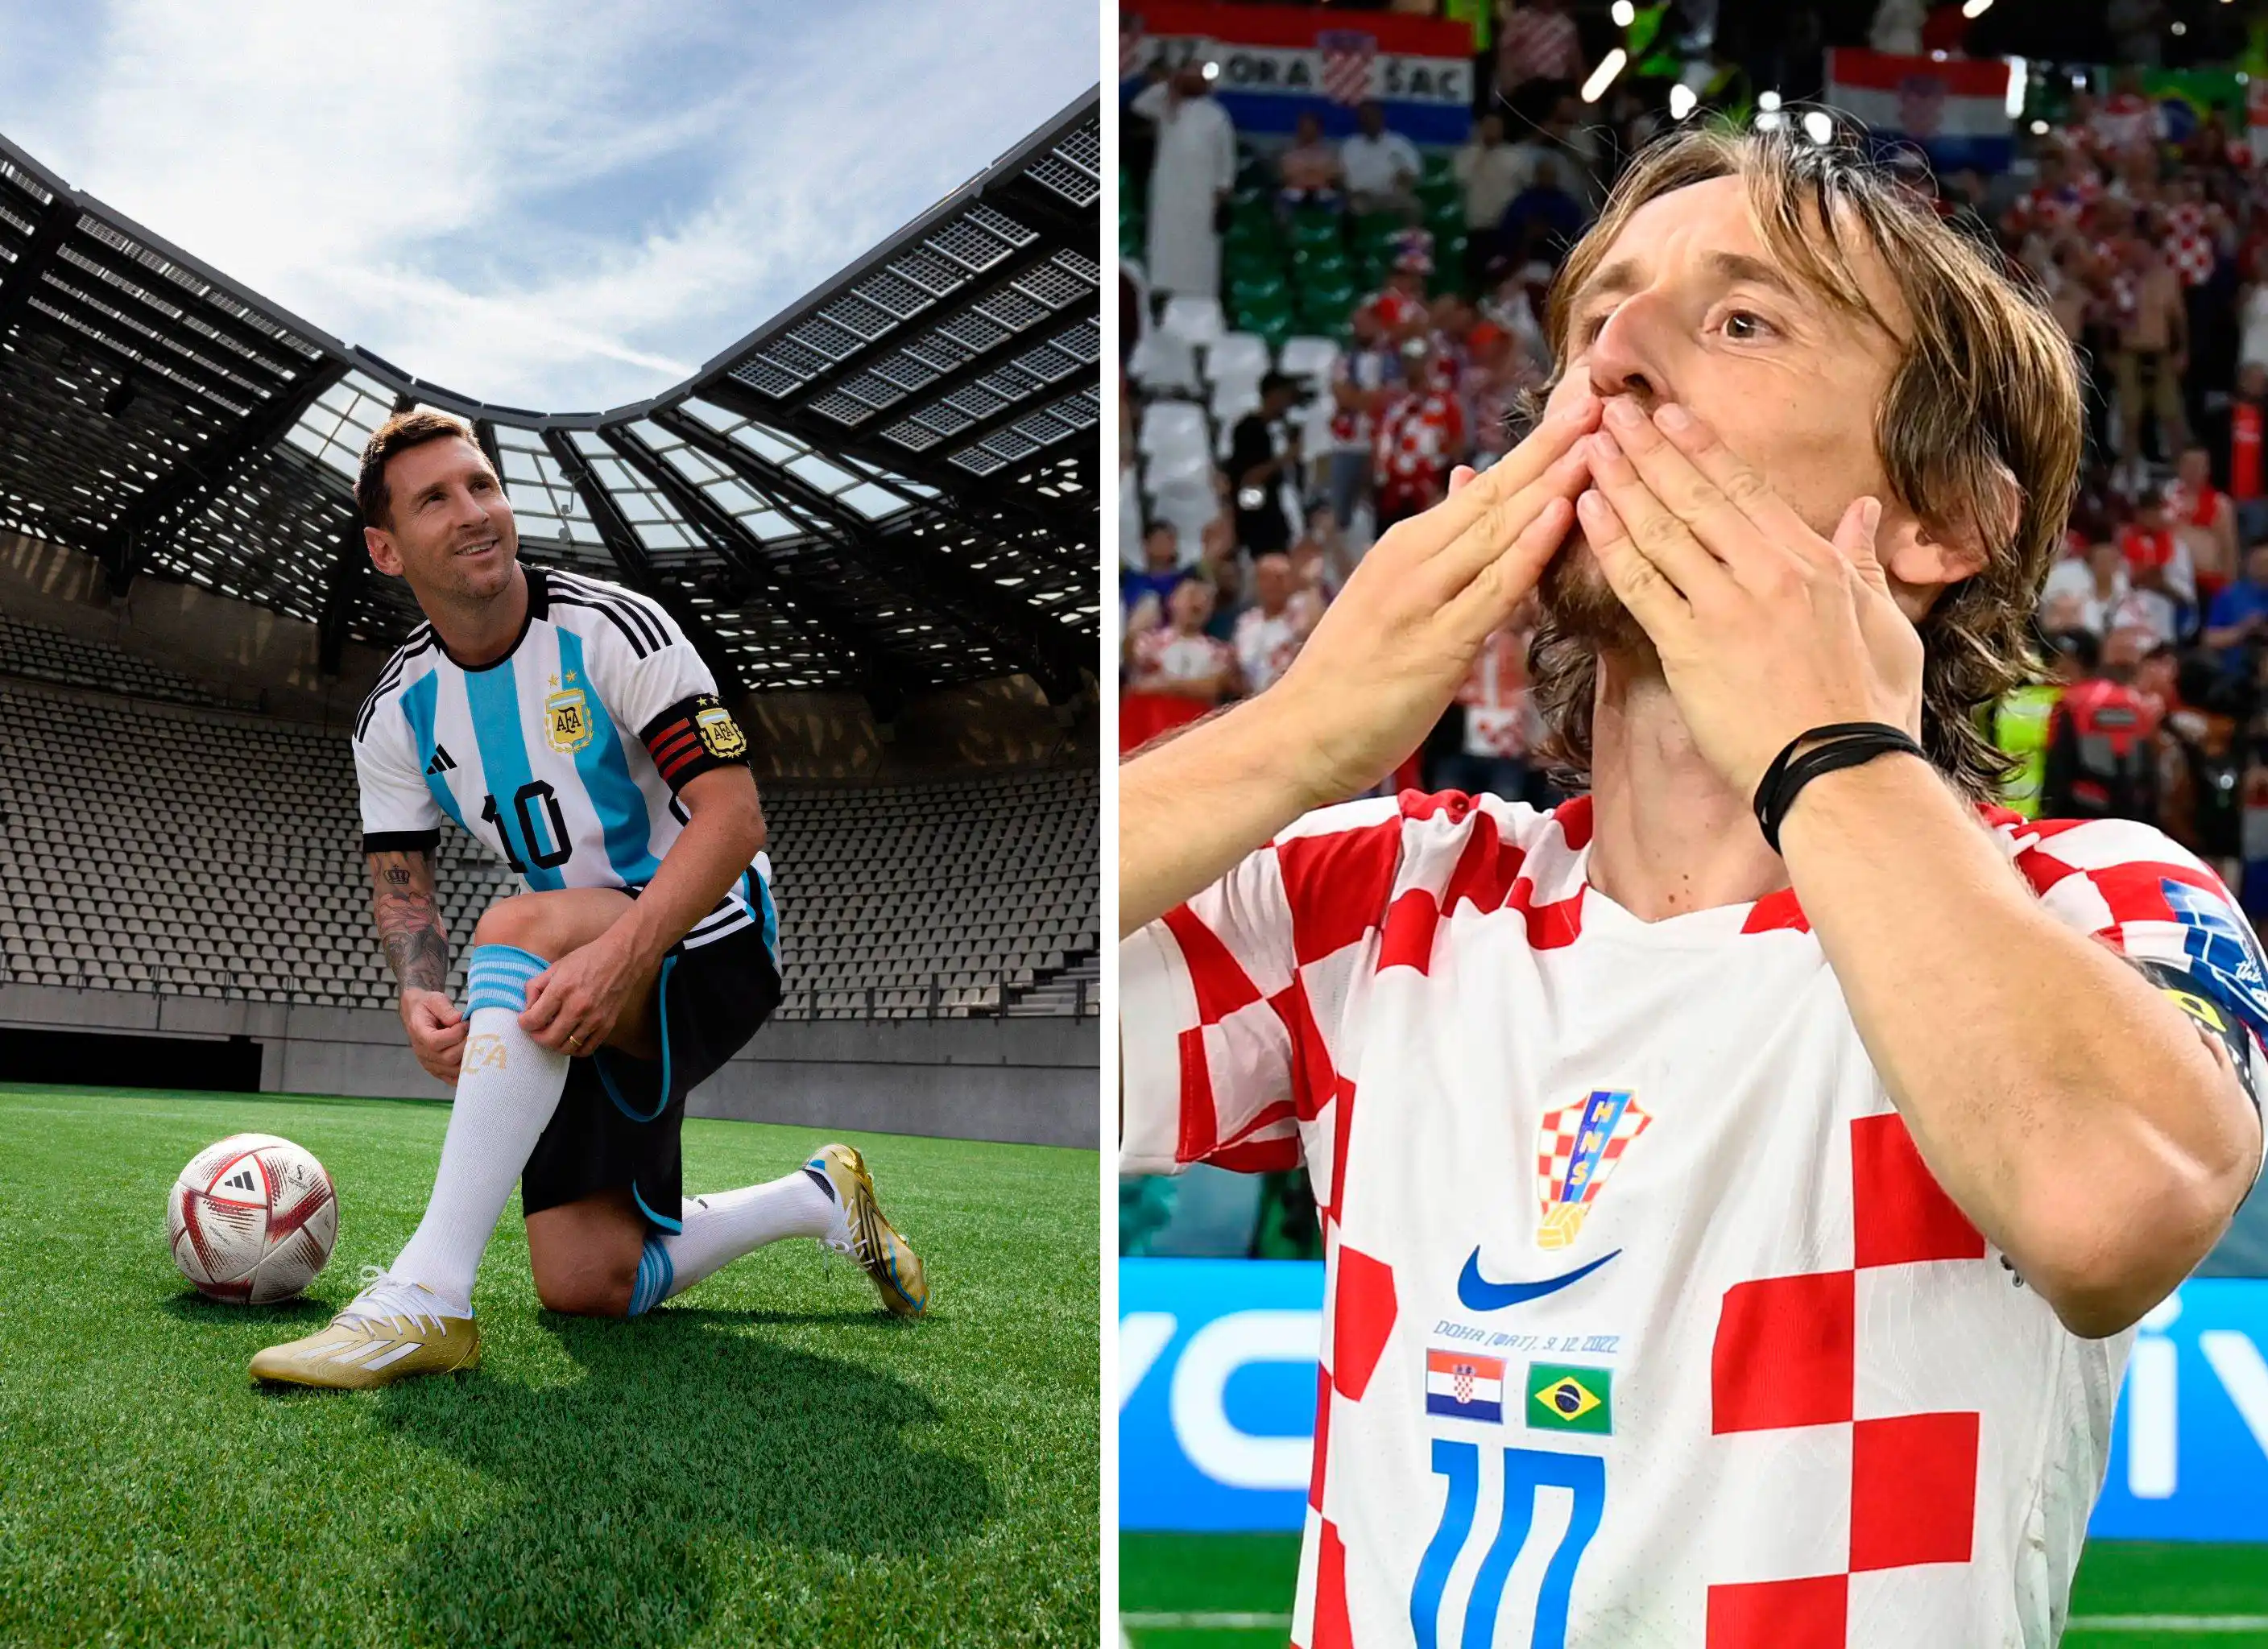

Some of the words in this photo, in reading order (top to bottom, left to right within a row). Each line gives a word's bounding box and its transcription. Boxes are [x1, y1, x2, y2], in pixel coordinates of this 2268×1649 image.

[556, 706, 581, 734] AFA
[714, 721, 735, 742] AFA
[481, 780, 573, 873] 10
[1568, 1101, 1616, 1186] HNS
[1434, 1320, 1486, 1342] DOHA
[1410, 1438, 1605, 1649] 10
